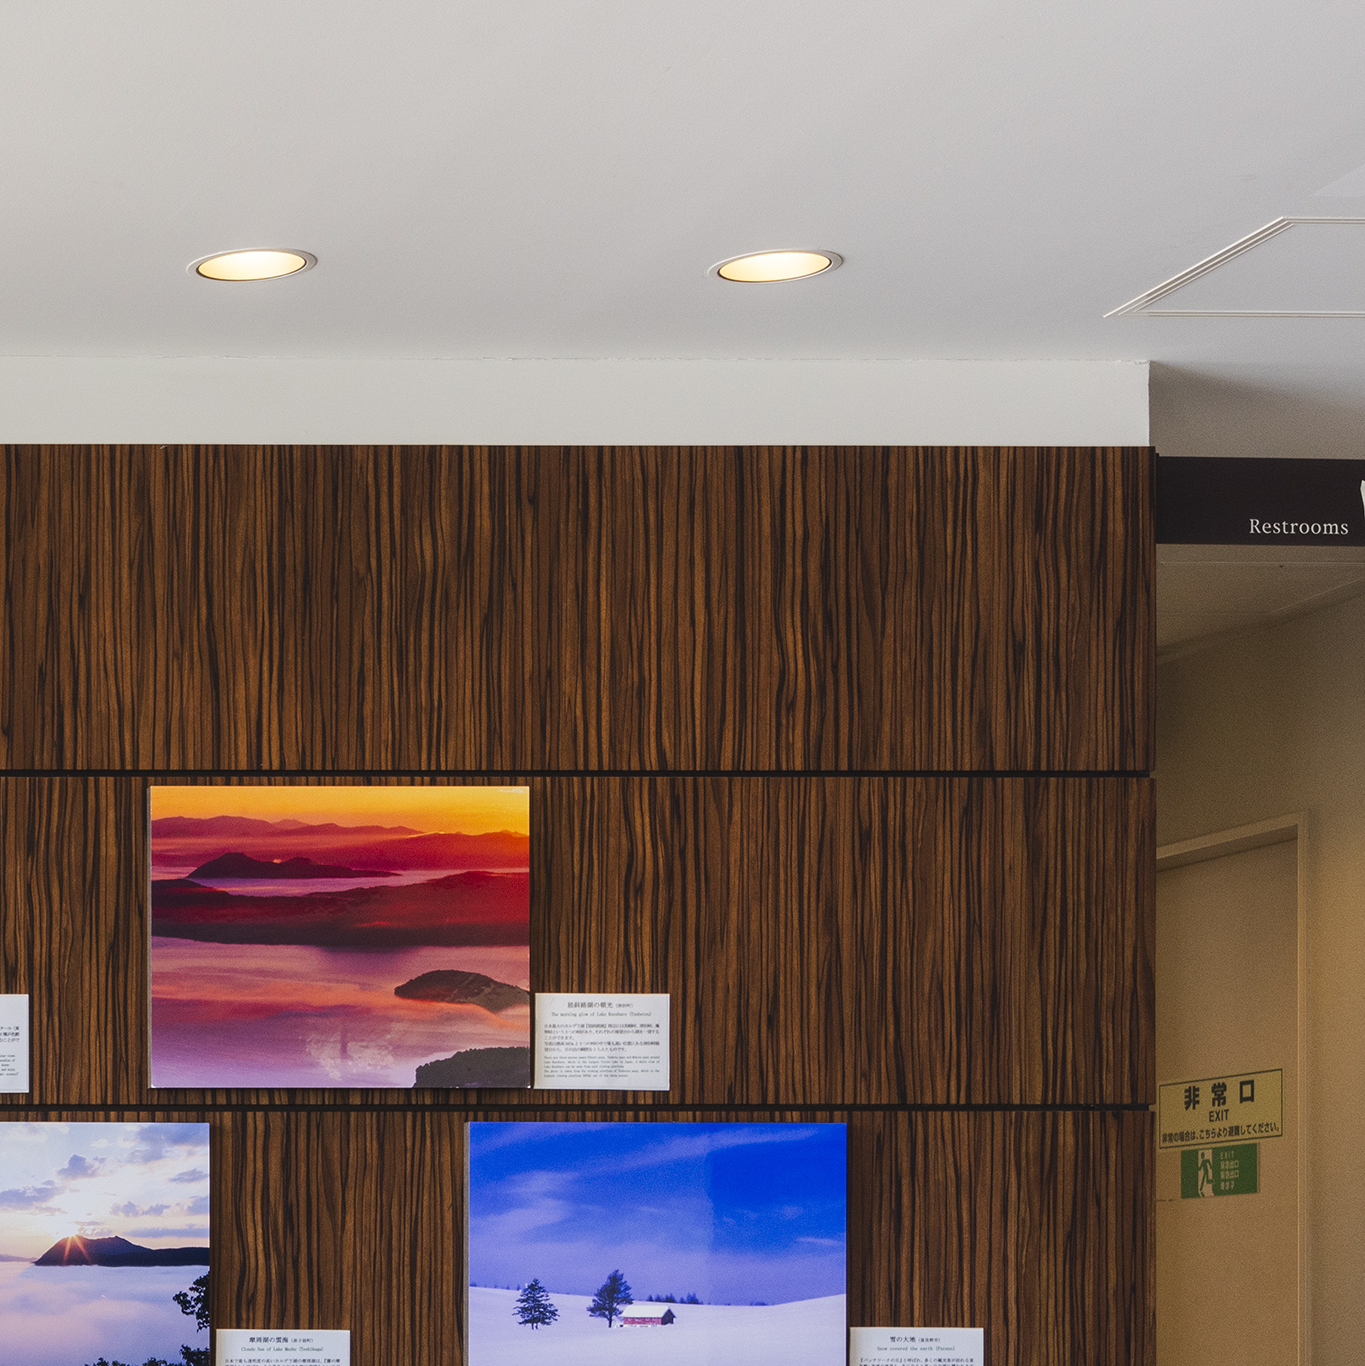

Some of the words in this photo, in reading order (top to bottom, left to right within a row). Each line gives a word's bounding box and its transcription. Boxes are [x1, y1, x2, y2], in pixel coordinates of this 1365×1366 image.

[1250, 519, 1348, 535] Restrooms
[1184, 1080, 1255, 1111] 非常口
[1209, 1109, 1229, 1122] EXIT
